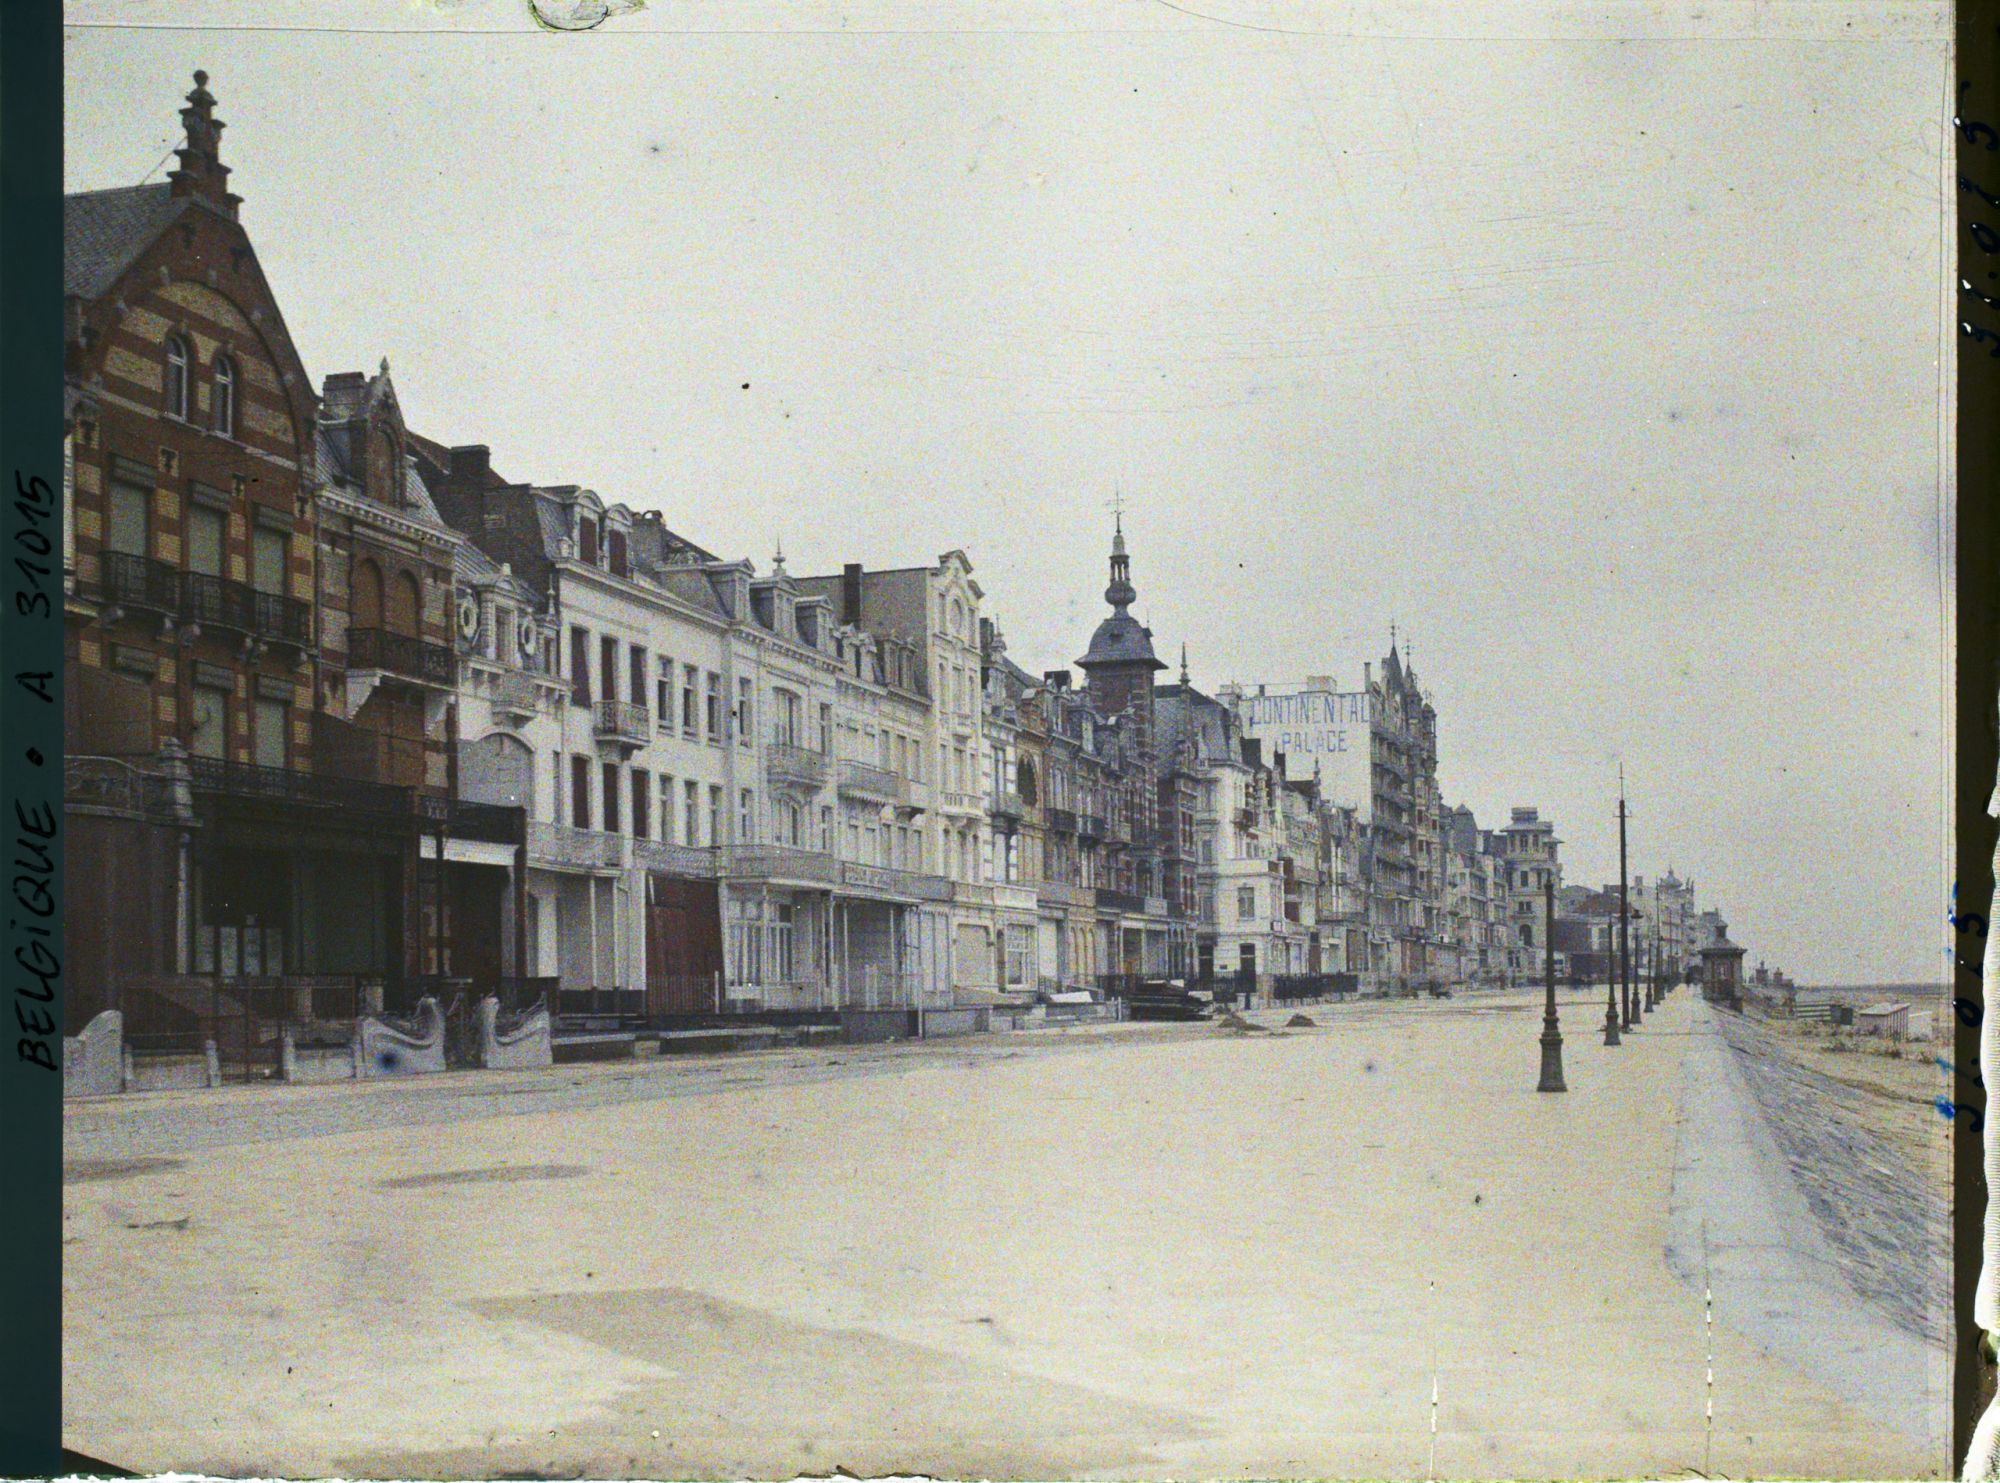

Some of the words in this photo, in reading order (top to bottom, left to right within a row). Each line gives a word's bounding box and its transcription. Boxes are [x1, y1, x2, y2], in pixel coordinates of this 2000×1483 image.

[14, 469, 54, 619] 31015
[14, 671, 54, 703] A
[1250, 694, 1369, 725] CONTINENTAL
[1282, 730, 1348, 753] PALACE
